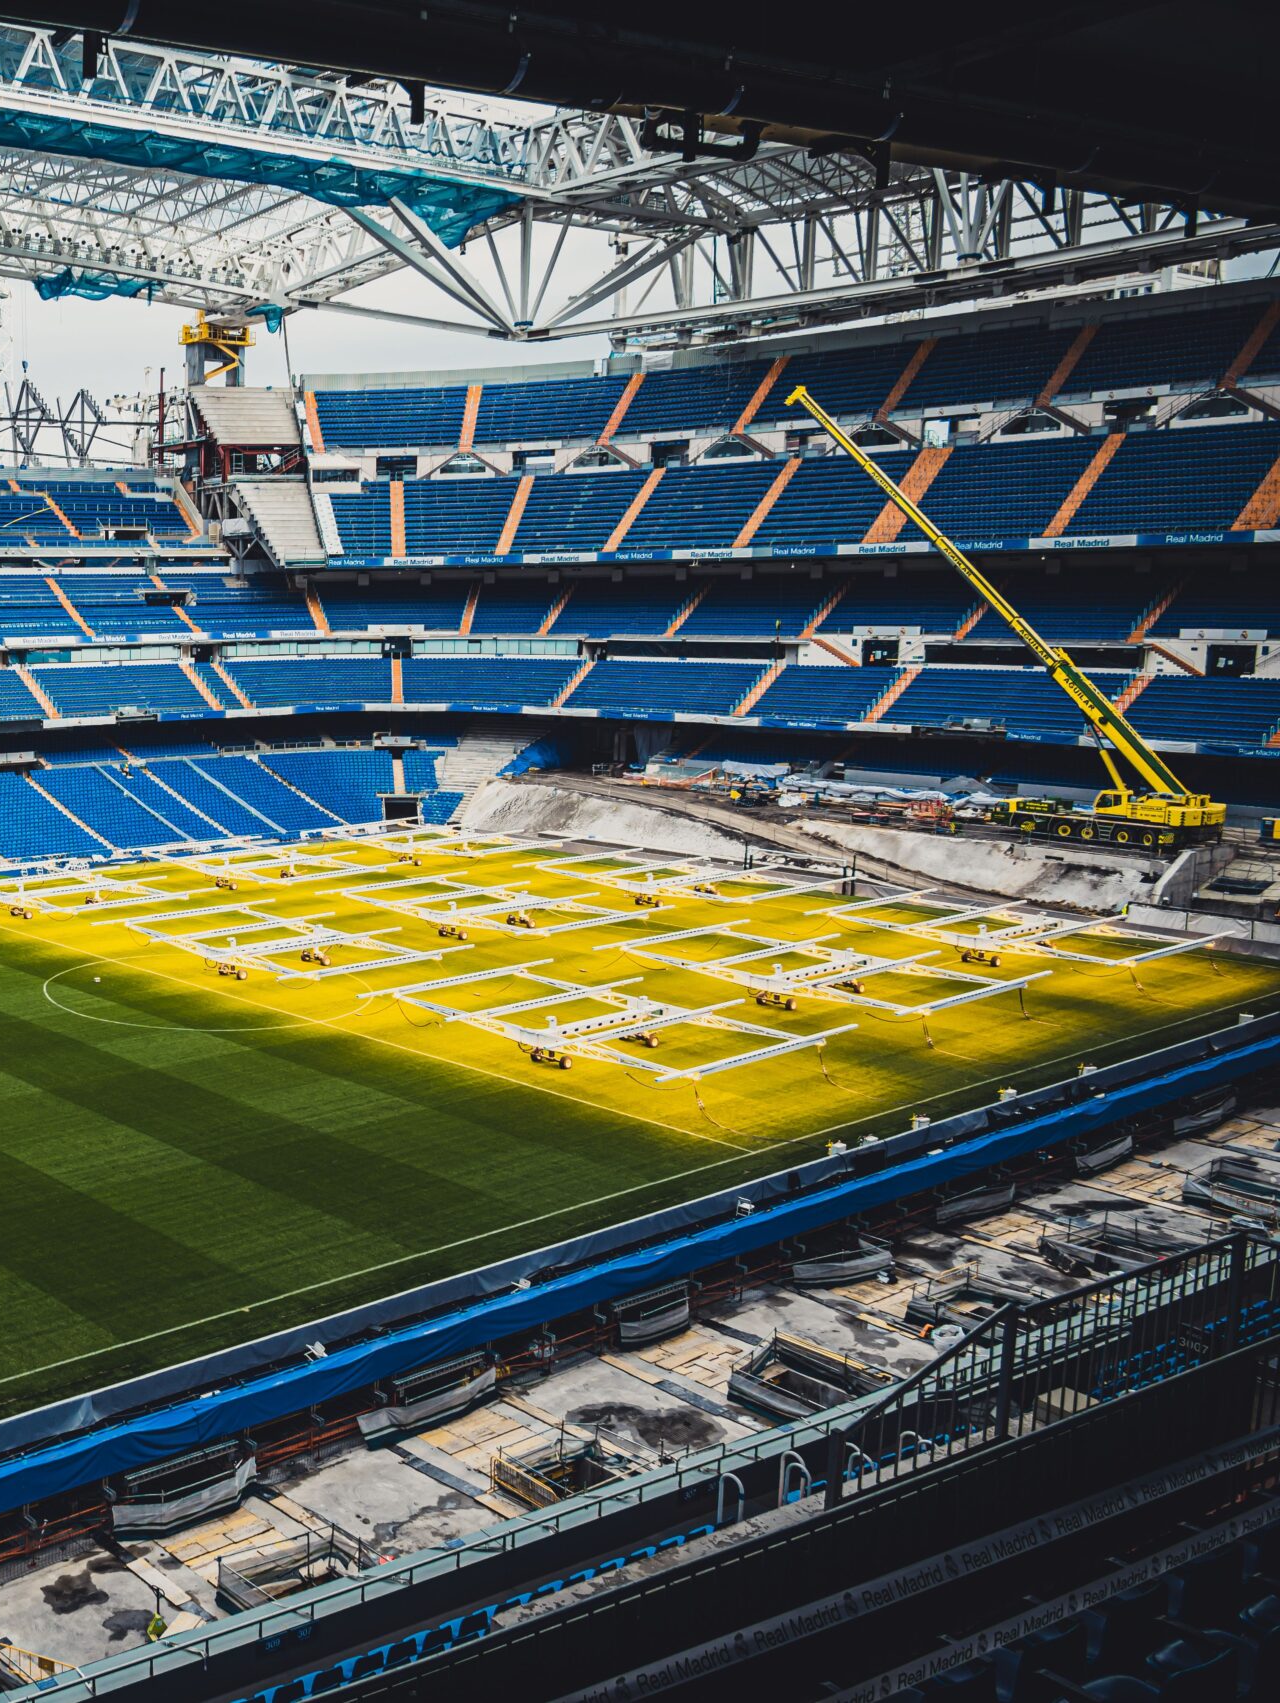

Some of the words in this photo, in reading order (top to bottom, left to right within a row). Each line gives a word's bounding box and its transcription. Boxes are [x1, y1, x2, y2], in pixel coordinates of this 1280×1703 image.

[803, 400, 828, 426] AGUILAR
[871, 472, 897, 498] AGUILAR
[878, 544, 906, 552] Madrid
[973, 541, 1003, 549] Madrid
[1054, 539, 1074, 547] Real
[1077, 538, 1110, 546] Madrid
[1166, 535, 1188, 543] Real
[1190, 532, 1223, 541] Madrid
[943, 548, 970, 577] AGUILAR
[1019, 629, 1049, 660] AGUILAR
[1063, 678, 1095, 711] AGUILAR
[1142, 1480, 1168, 1501] Real
[1170, 1465, 1207, 1492] Madrid
[1055, 1512, 1082, 1534] Real
[1084, 1495, 1125, 1524] Madrid
[1242, 1515, 1263, 1533] Real
[962, 1546, 993, 1571] Real
[993, 1528, 1037, 1559] Madrid
[1165, 1548, 1188, 1570] Real
[1190, 1534, 1228, 1557] Madrid
[862, 1583, 895, 1608] Real
[896, 1564, 944, 1597] Madrid
[1082, 1587, 1108, 1608] Real
[1111, 1570, 1149, 1597] Madrid
[753, 1622, 790, 1651] Real
[790, 1603, 841, 1637] Madrid
[993, 1624, 1021, 1647] Real
[1023, 1606, 1065, 1635] Madrid
[636, 1665, 673, 1694] Real
[677, 1643, 731, 1680] Madrid
[897, 1664, 926, 1689] Real
[929, 1644, 973, 1676] Madrid
